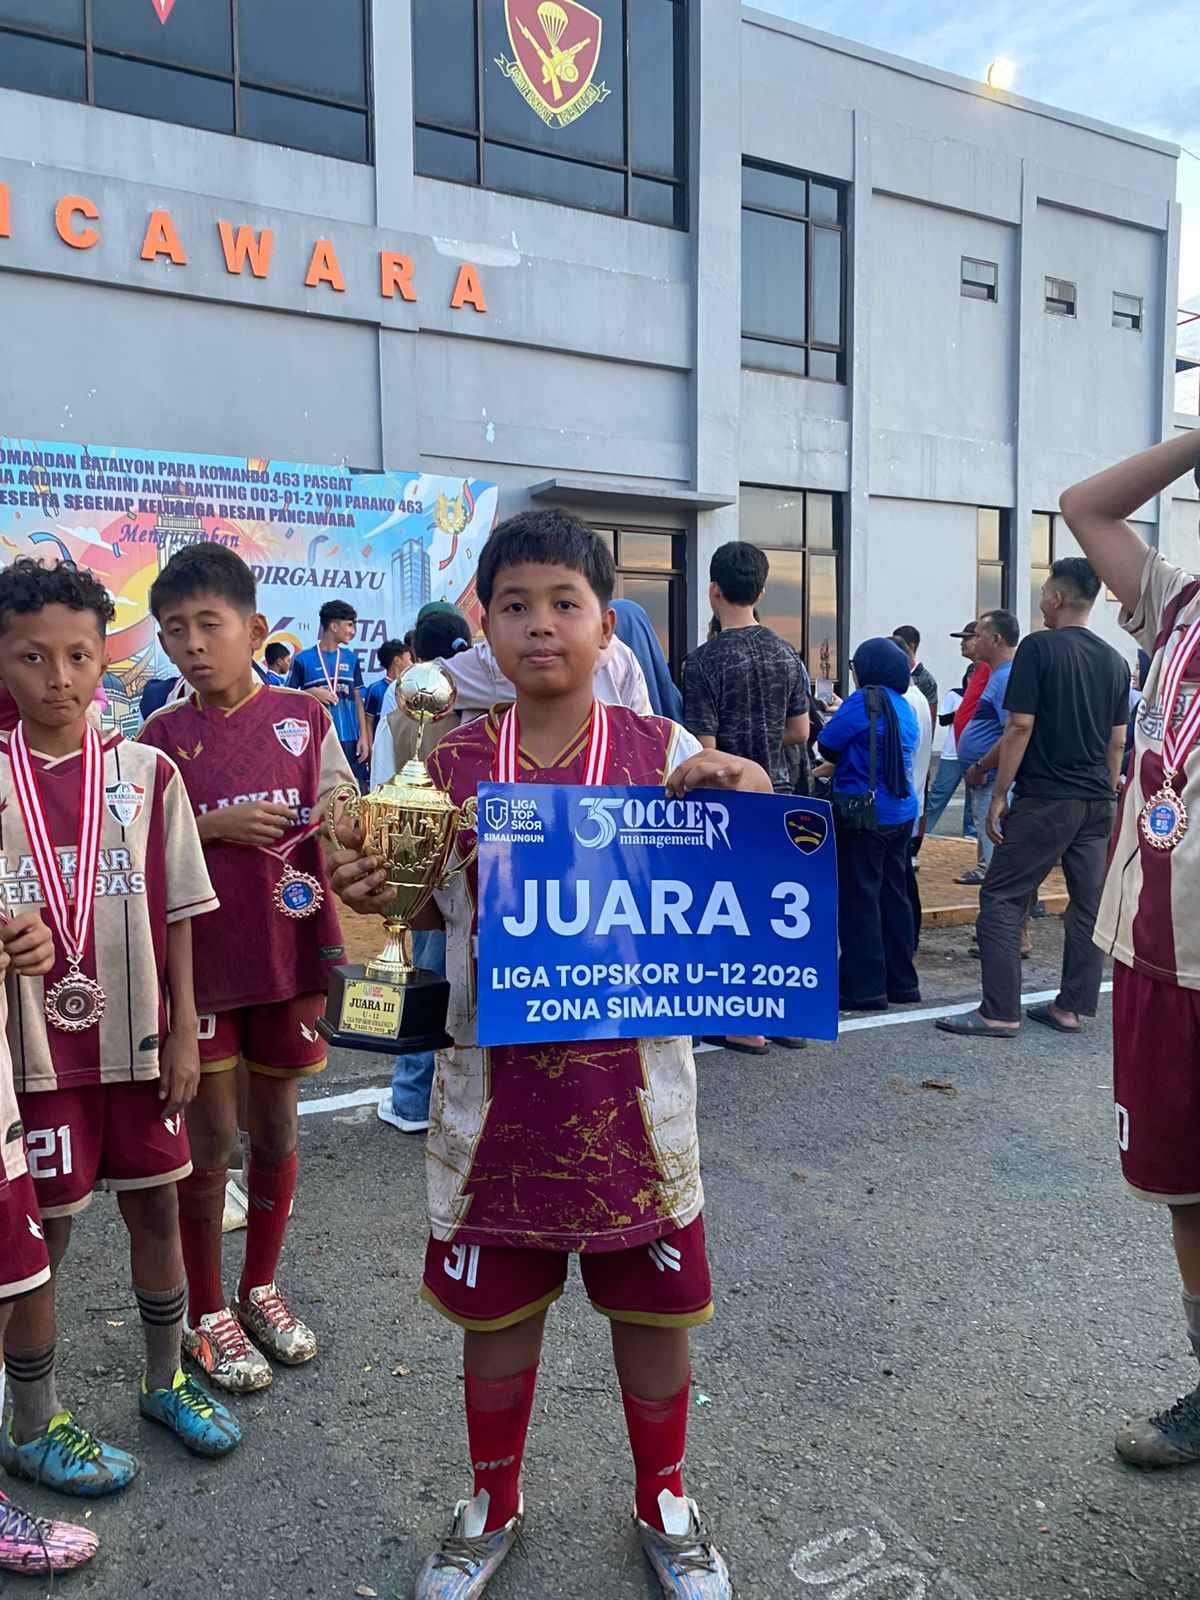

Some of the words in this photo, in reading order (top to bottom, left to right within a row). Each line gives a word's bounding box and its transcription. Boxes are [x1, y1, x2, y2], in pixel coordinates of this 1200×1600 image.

[81, 454, 155, 475] BATALYON
[158, 461, 196, 479] PARA
[200, 465, 270, 485] KOMANDO
[273, 471, 300, 487] 463
[303, 473, 354, 492] PASGAT
[18, 469, 82, 489] ARDHYA
[85, 474, 138, 492] GARINI
[184, 481, 247, 500] RANTING
[251, 487, 313, 506] 003-01-2
[315, 491, 342, 509] YON
[345, 495, 395, 512] PARAKO
[398, 499, 423, 514] 463
[63, 493, 134, 513] SEGENAP
[218, 503, 266, 521] BESAR
[269, 507, 356, 528] PANCAWARA
[251, 564, 387, 590] DIRGAHAYU
[510, 799, 538, 810] LIGA
[511, 810, 535, 820] TOP
[483, 832, 545, 843] SIMALUNGUN
[620, 833, 705, 849] management
[501, 878, 752, 938] JUARA
[769, 880, 812, 940] 3
[491, 965, 551, 990] LIGA
[556, 962, 679, 987] TOPSKOR
[686, 961, 747, 985] U-12
[751, 963, 819, 989] 2026
[349, 997, 381, 1011] JUARA
[383, 1002, 396, 1013] III
[525, 997, 601, 1023] ZONA
[606, 995, 786, 1020] SIMALUNGUN
[26, 1124, 73, 1179] 21
